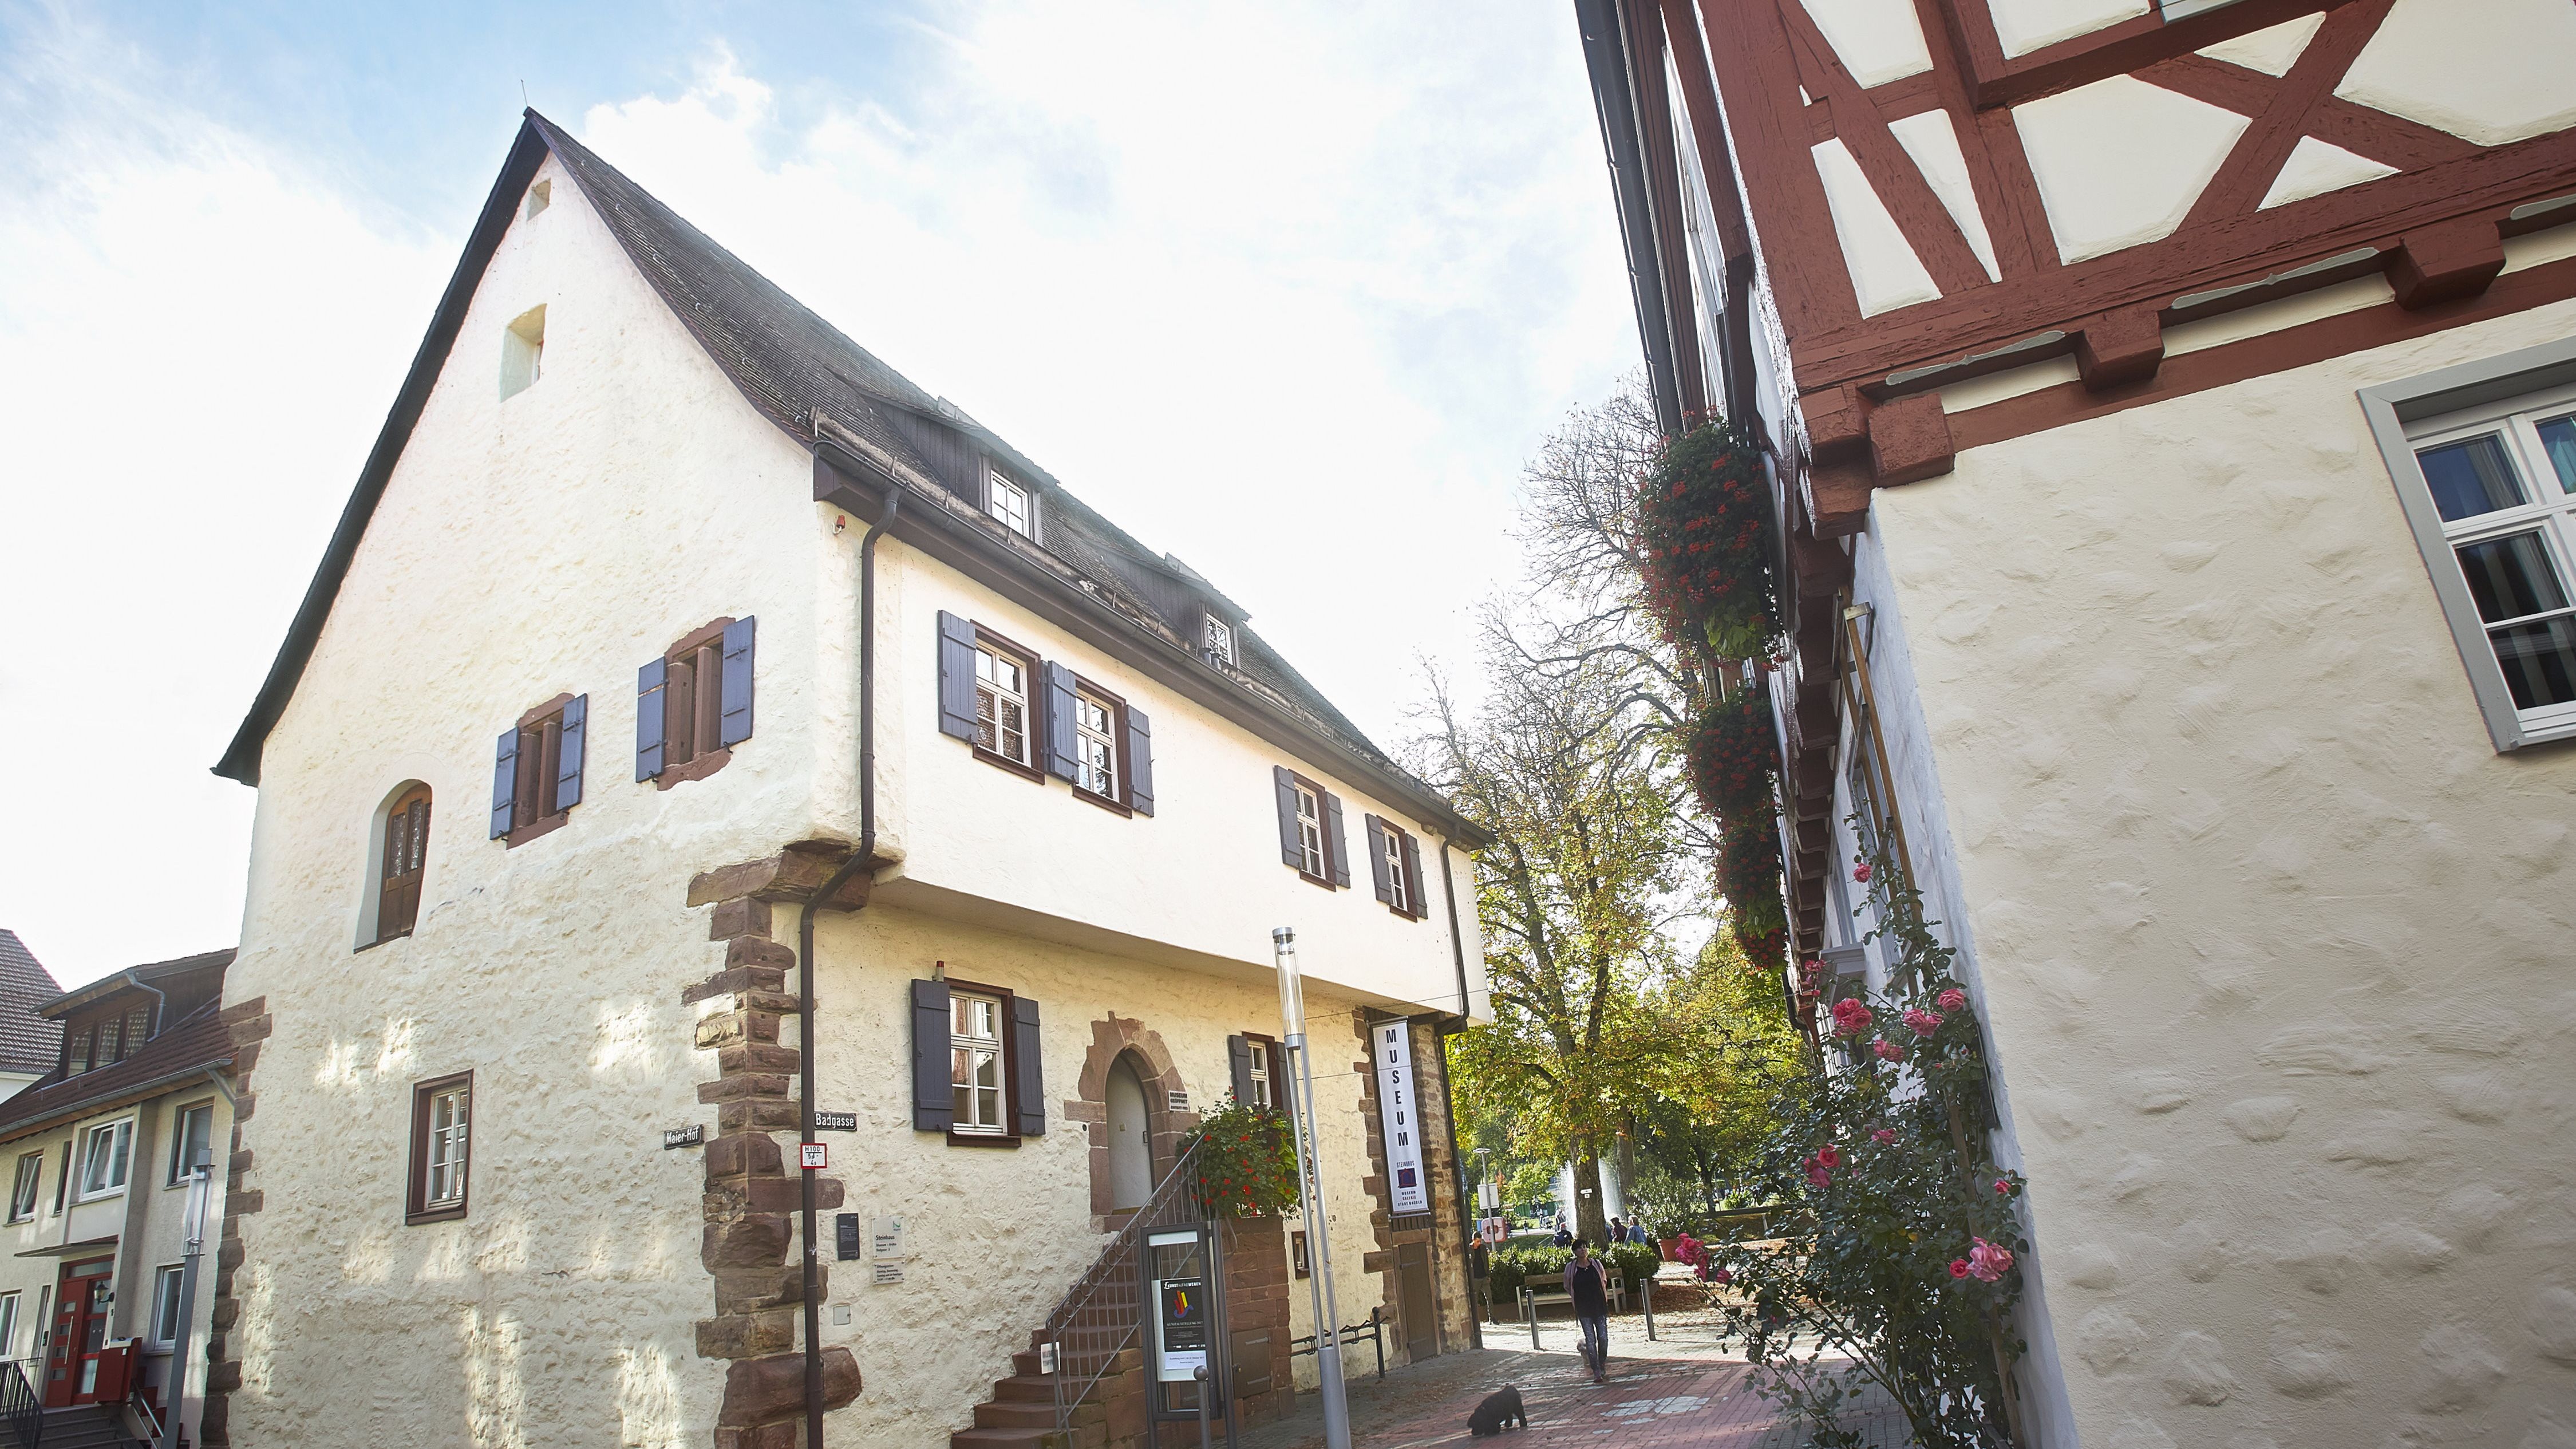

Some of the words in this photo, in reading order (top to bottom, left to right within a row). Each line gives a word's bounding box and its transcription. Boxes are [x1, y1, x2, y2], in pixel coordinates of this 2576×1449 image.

[1385, 1029, 1409, 1146] MUSEUM
[815, 1113, 854, 1128] Badgasse
[666, 1126, 700, 1144] Maier-Hof
